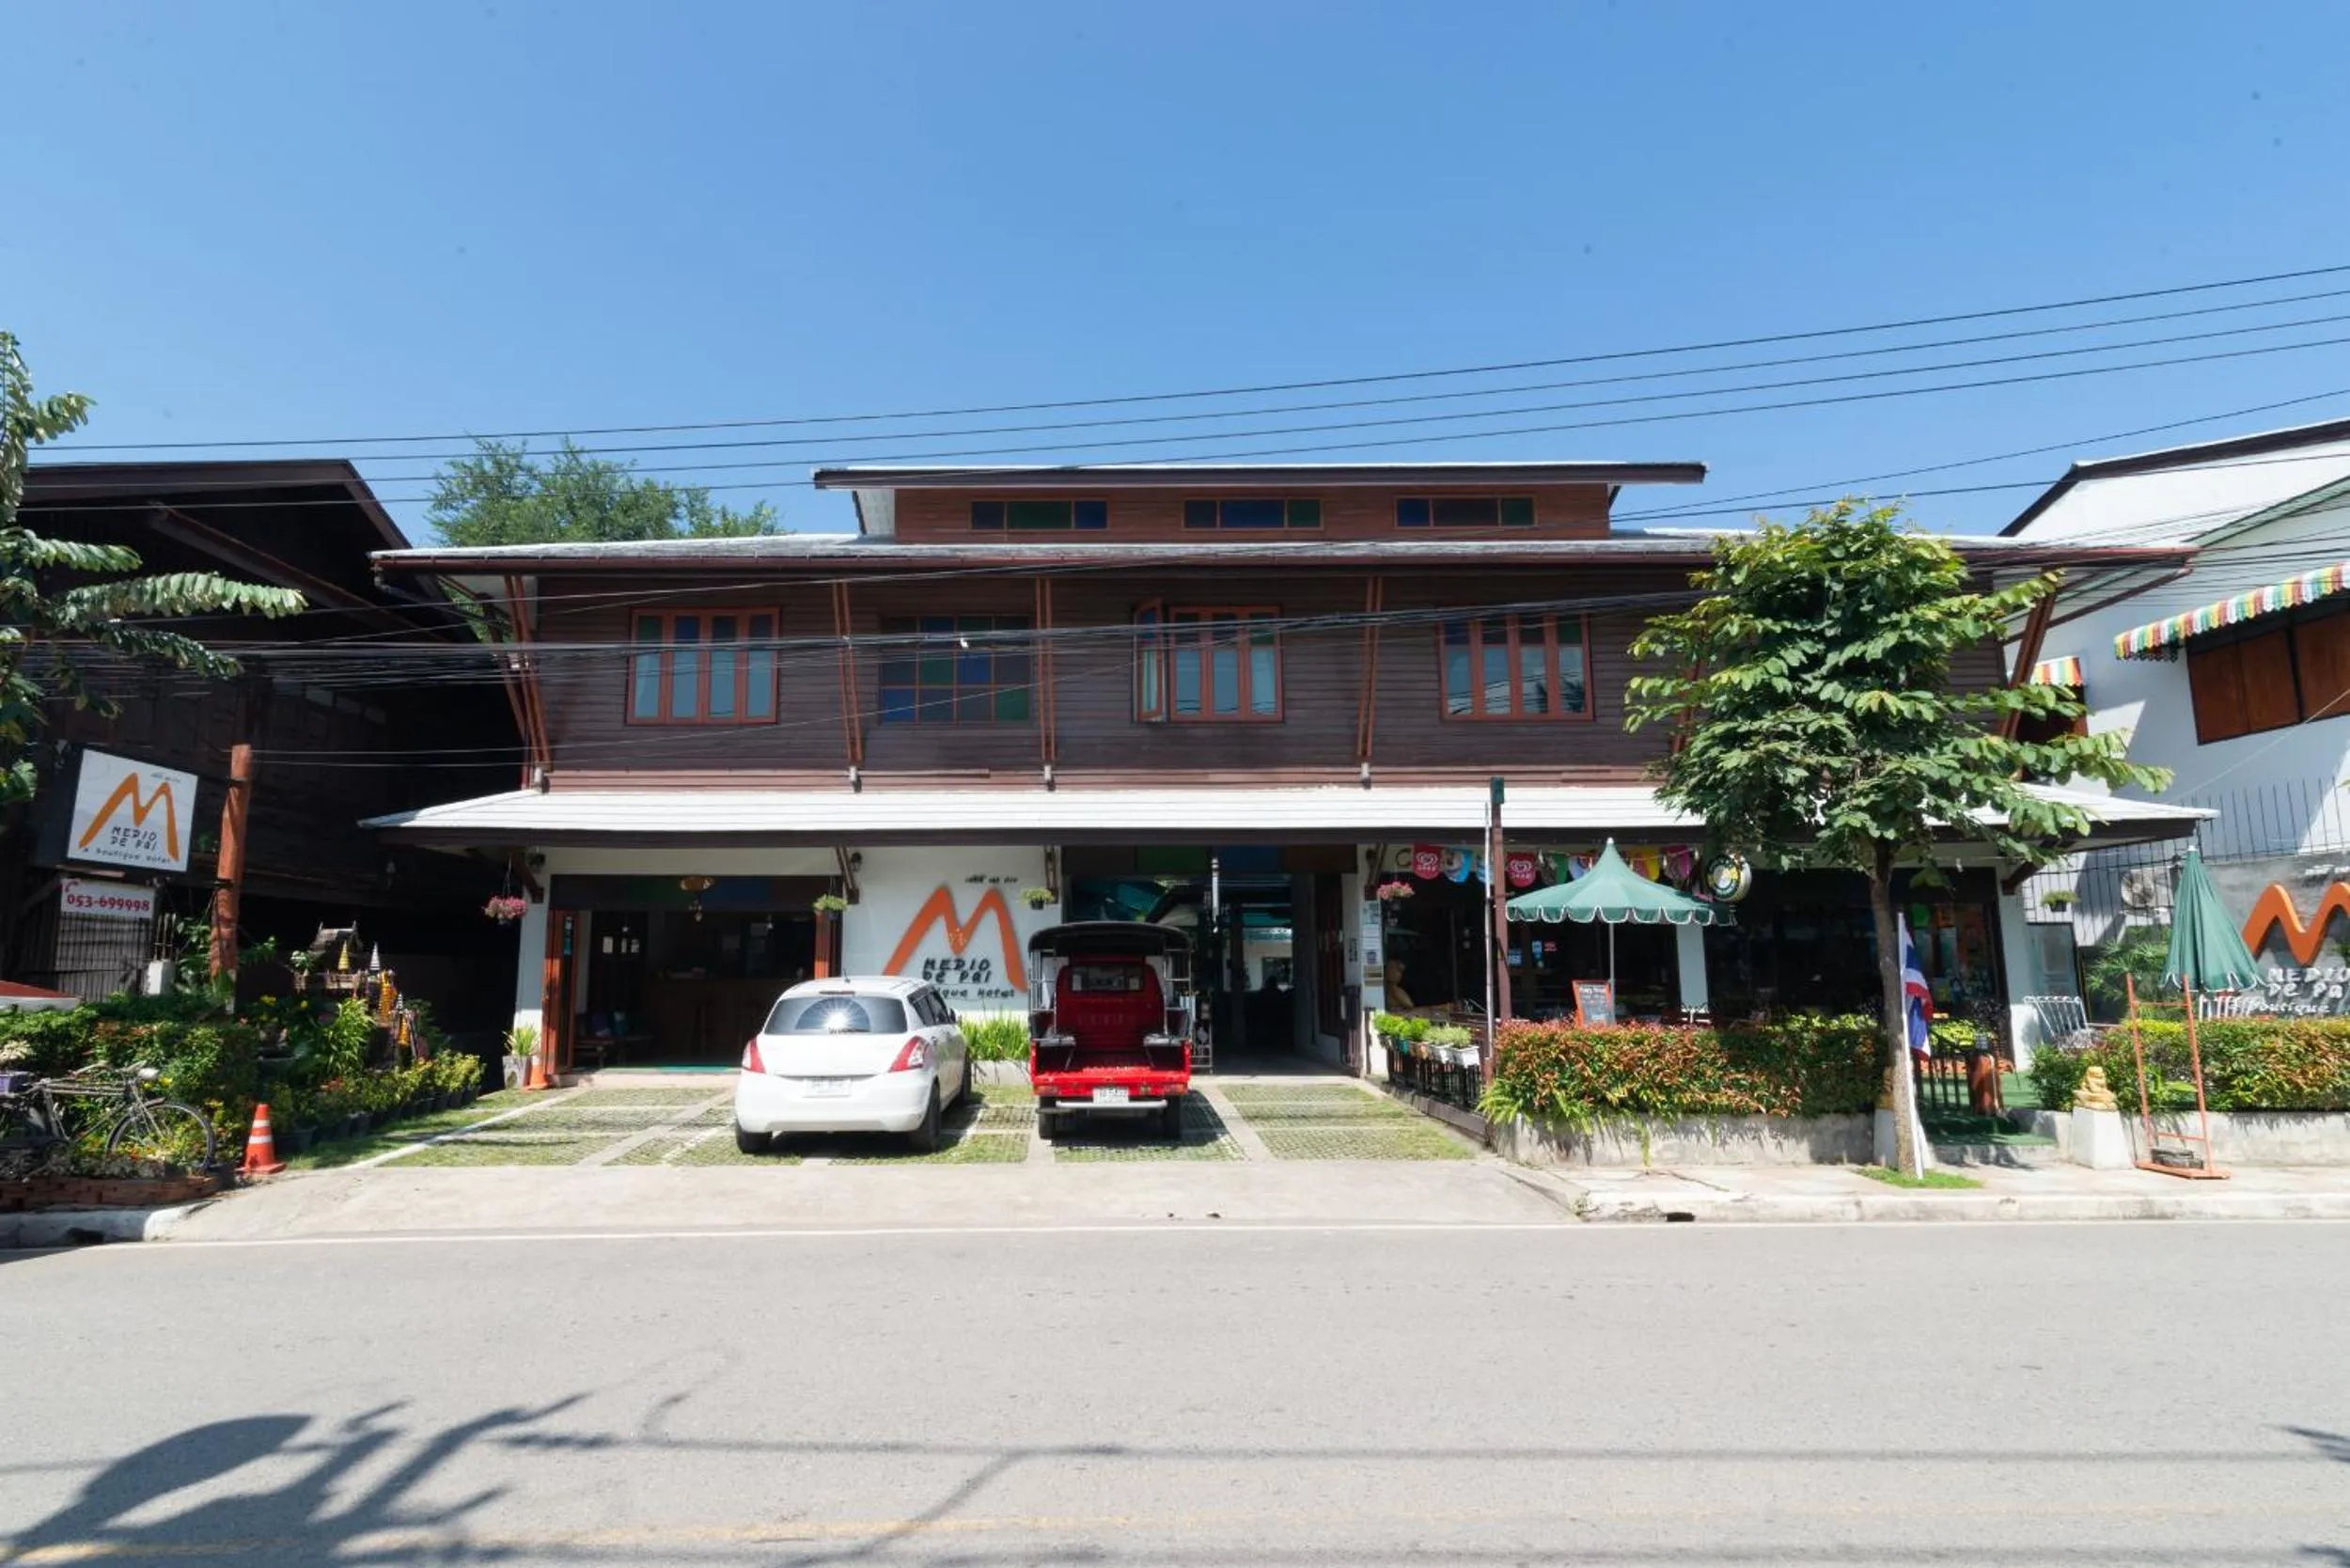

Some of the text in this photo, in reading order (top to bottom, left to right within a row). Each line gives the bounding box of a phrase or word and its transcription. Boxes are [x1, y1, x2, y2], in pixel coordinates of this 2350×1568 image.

[112, 826, 157, 842] MEDIO
[67, 894, 150, 912] 053-699998
[923, 957, 991, 971] MEDIO
[2267, 967, 2350, 983] MEDIO
